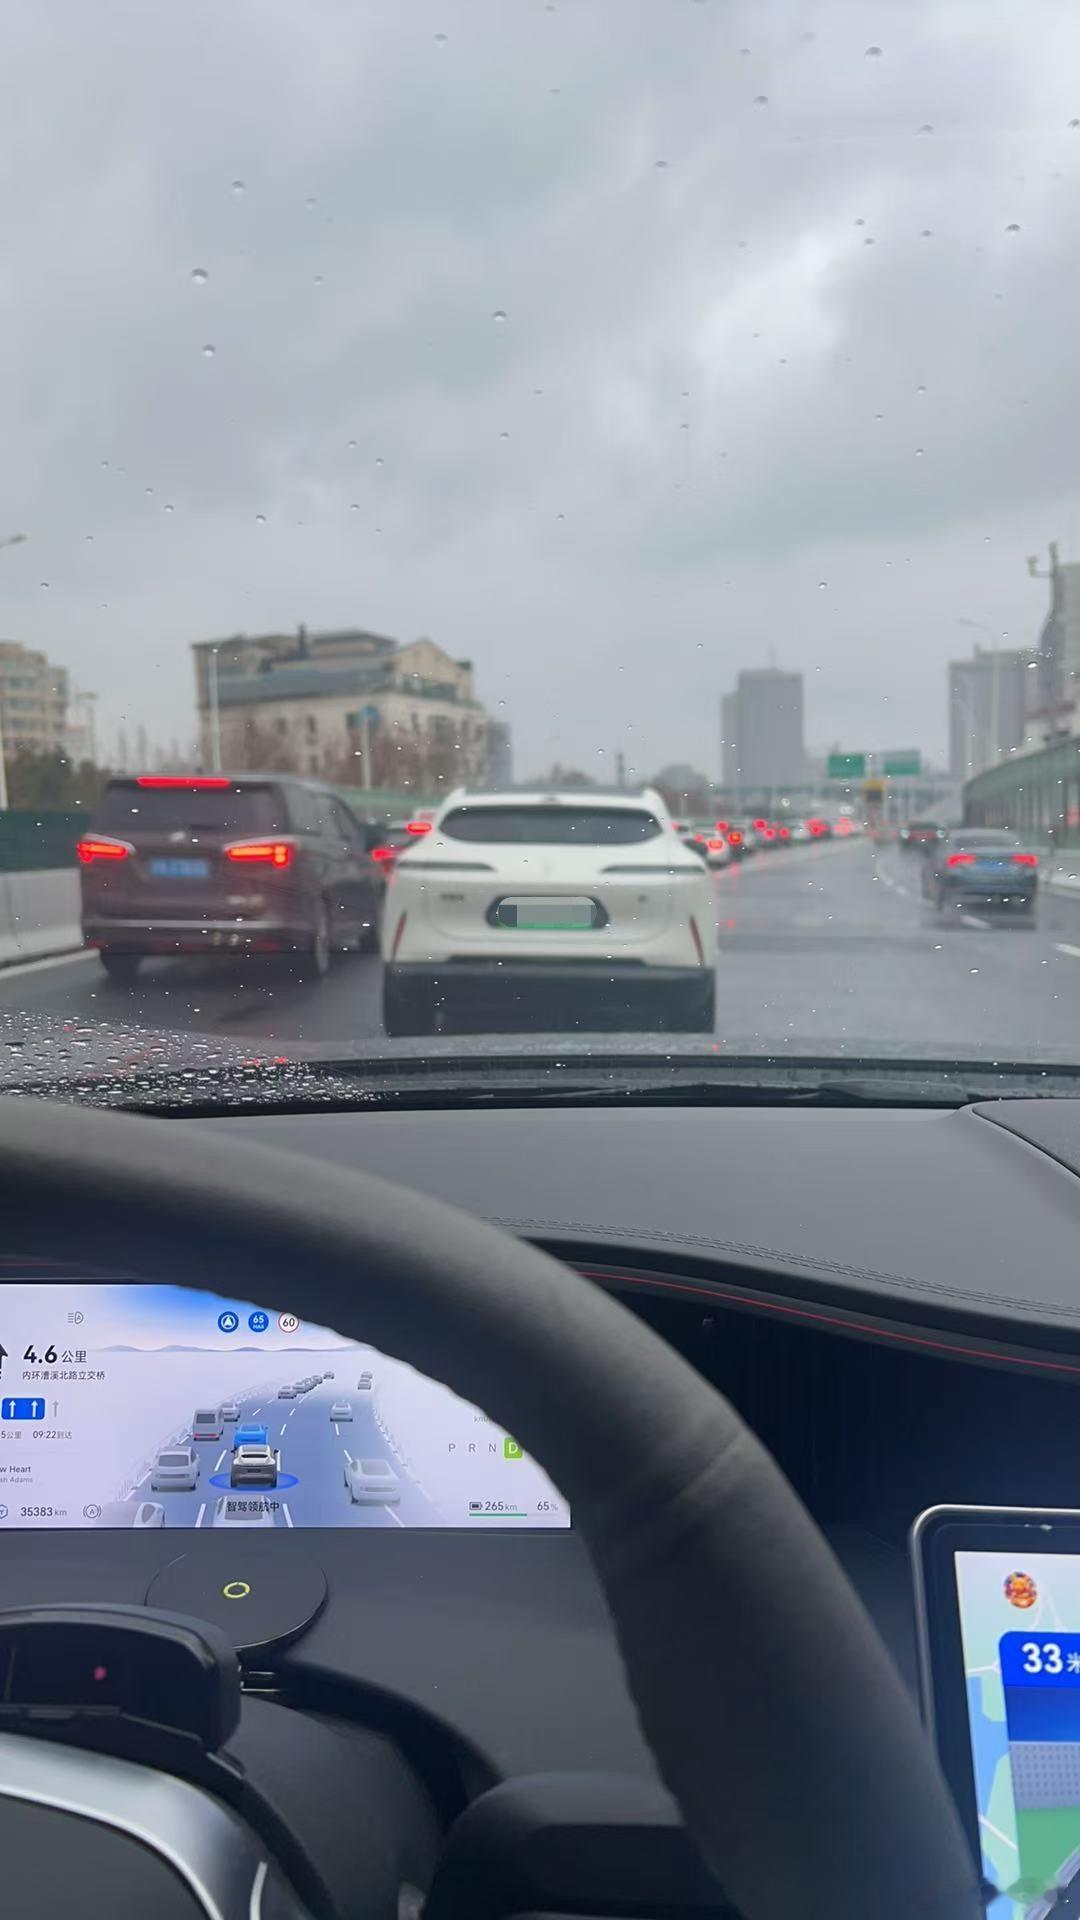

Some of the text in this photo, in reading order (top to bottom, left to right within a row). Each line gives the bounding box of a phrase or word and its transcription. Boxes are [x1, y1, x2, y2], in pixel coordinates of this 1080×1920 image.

[253, 1315, 264, 1324] 65
[282, 1318, 295, 1327] 60
[23, 1344, 87, 1364] 4.6 公里
[448, 1442, 519, 1454] P R N D
[9, 1465, 31, 1473] Heart
[20, 1506, 53, 1517] 35383
[227, 1501, 280, 1513] 智驾领航中
[1022, 1642, 1063, 1674] 33
